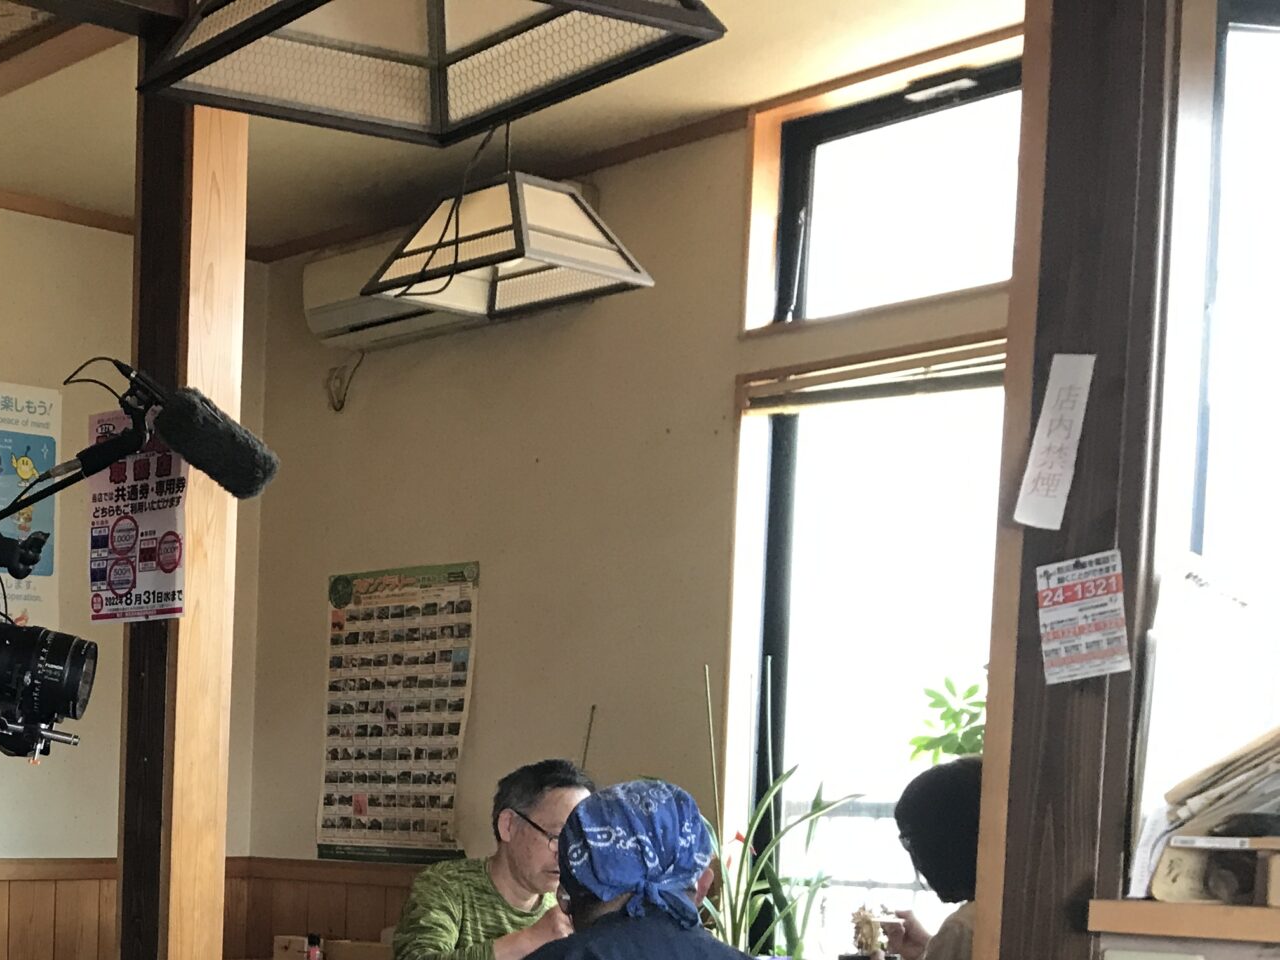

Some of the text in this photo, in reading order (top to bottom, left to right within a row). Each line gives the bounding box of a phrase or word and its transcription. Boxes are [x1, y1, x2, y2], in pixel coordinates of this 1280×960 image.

[1026, 383, 1084, 499] 店内禁煙
[1043, 577, 1118, 606] 24-1321
